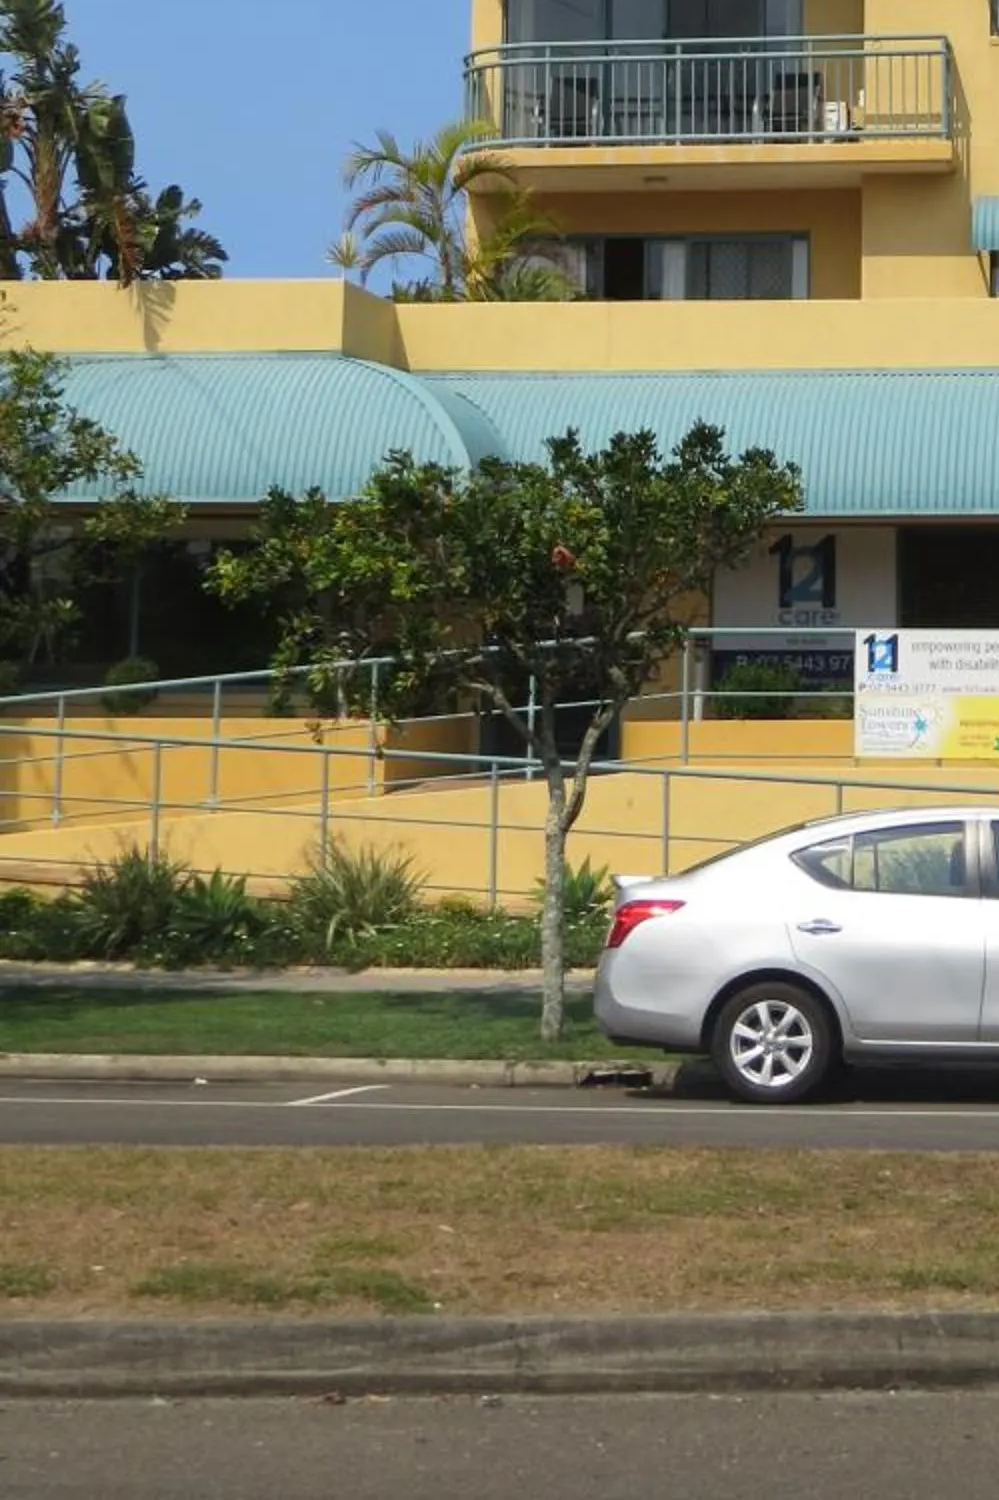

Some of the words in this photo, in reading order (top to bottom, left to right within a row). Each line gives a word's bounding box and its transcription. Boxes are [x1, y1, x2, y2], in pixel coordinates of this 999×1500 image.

[778, 608, 835, 626] care
[911, 640, 981, 655] empowering
[829, 654, 850, 672] 97
[929, 658, 953, 671] with
